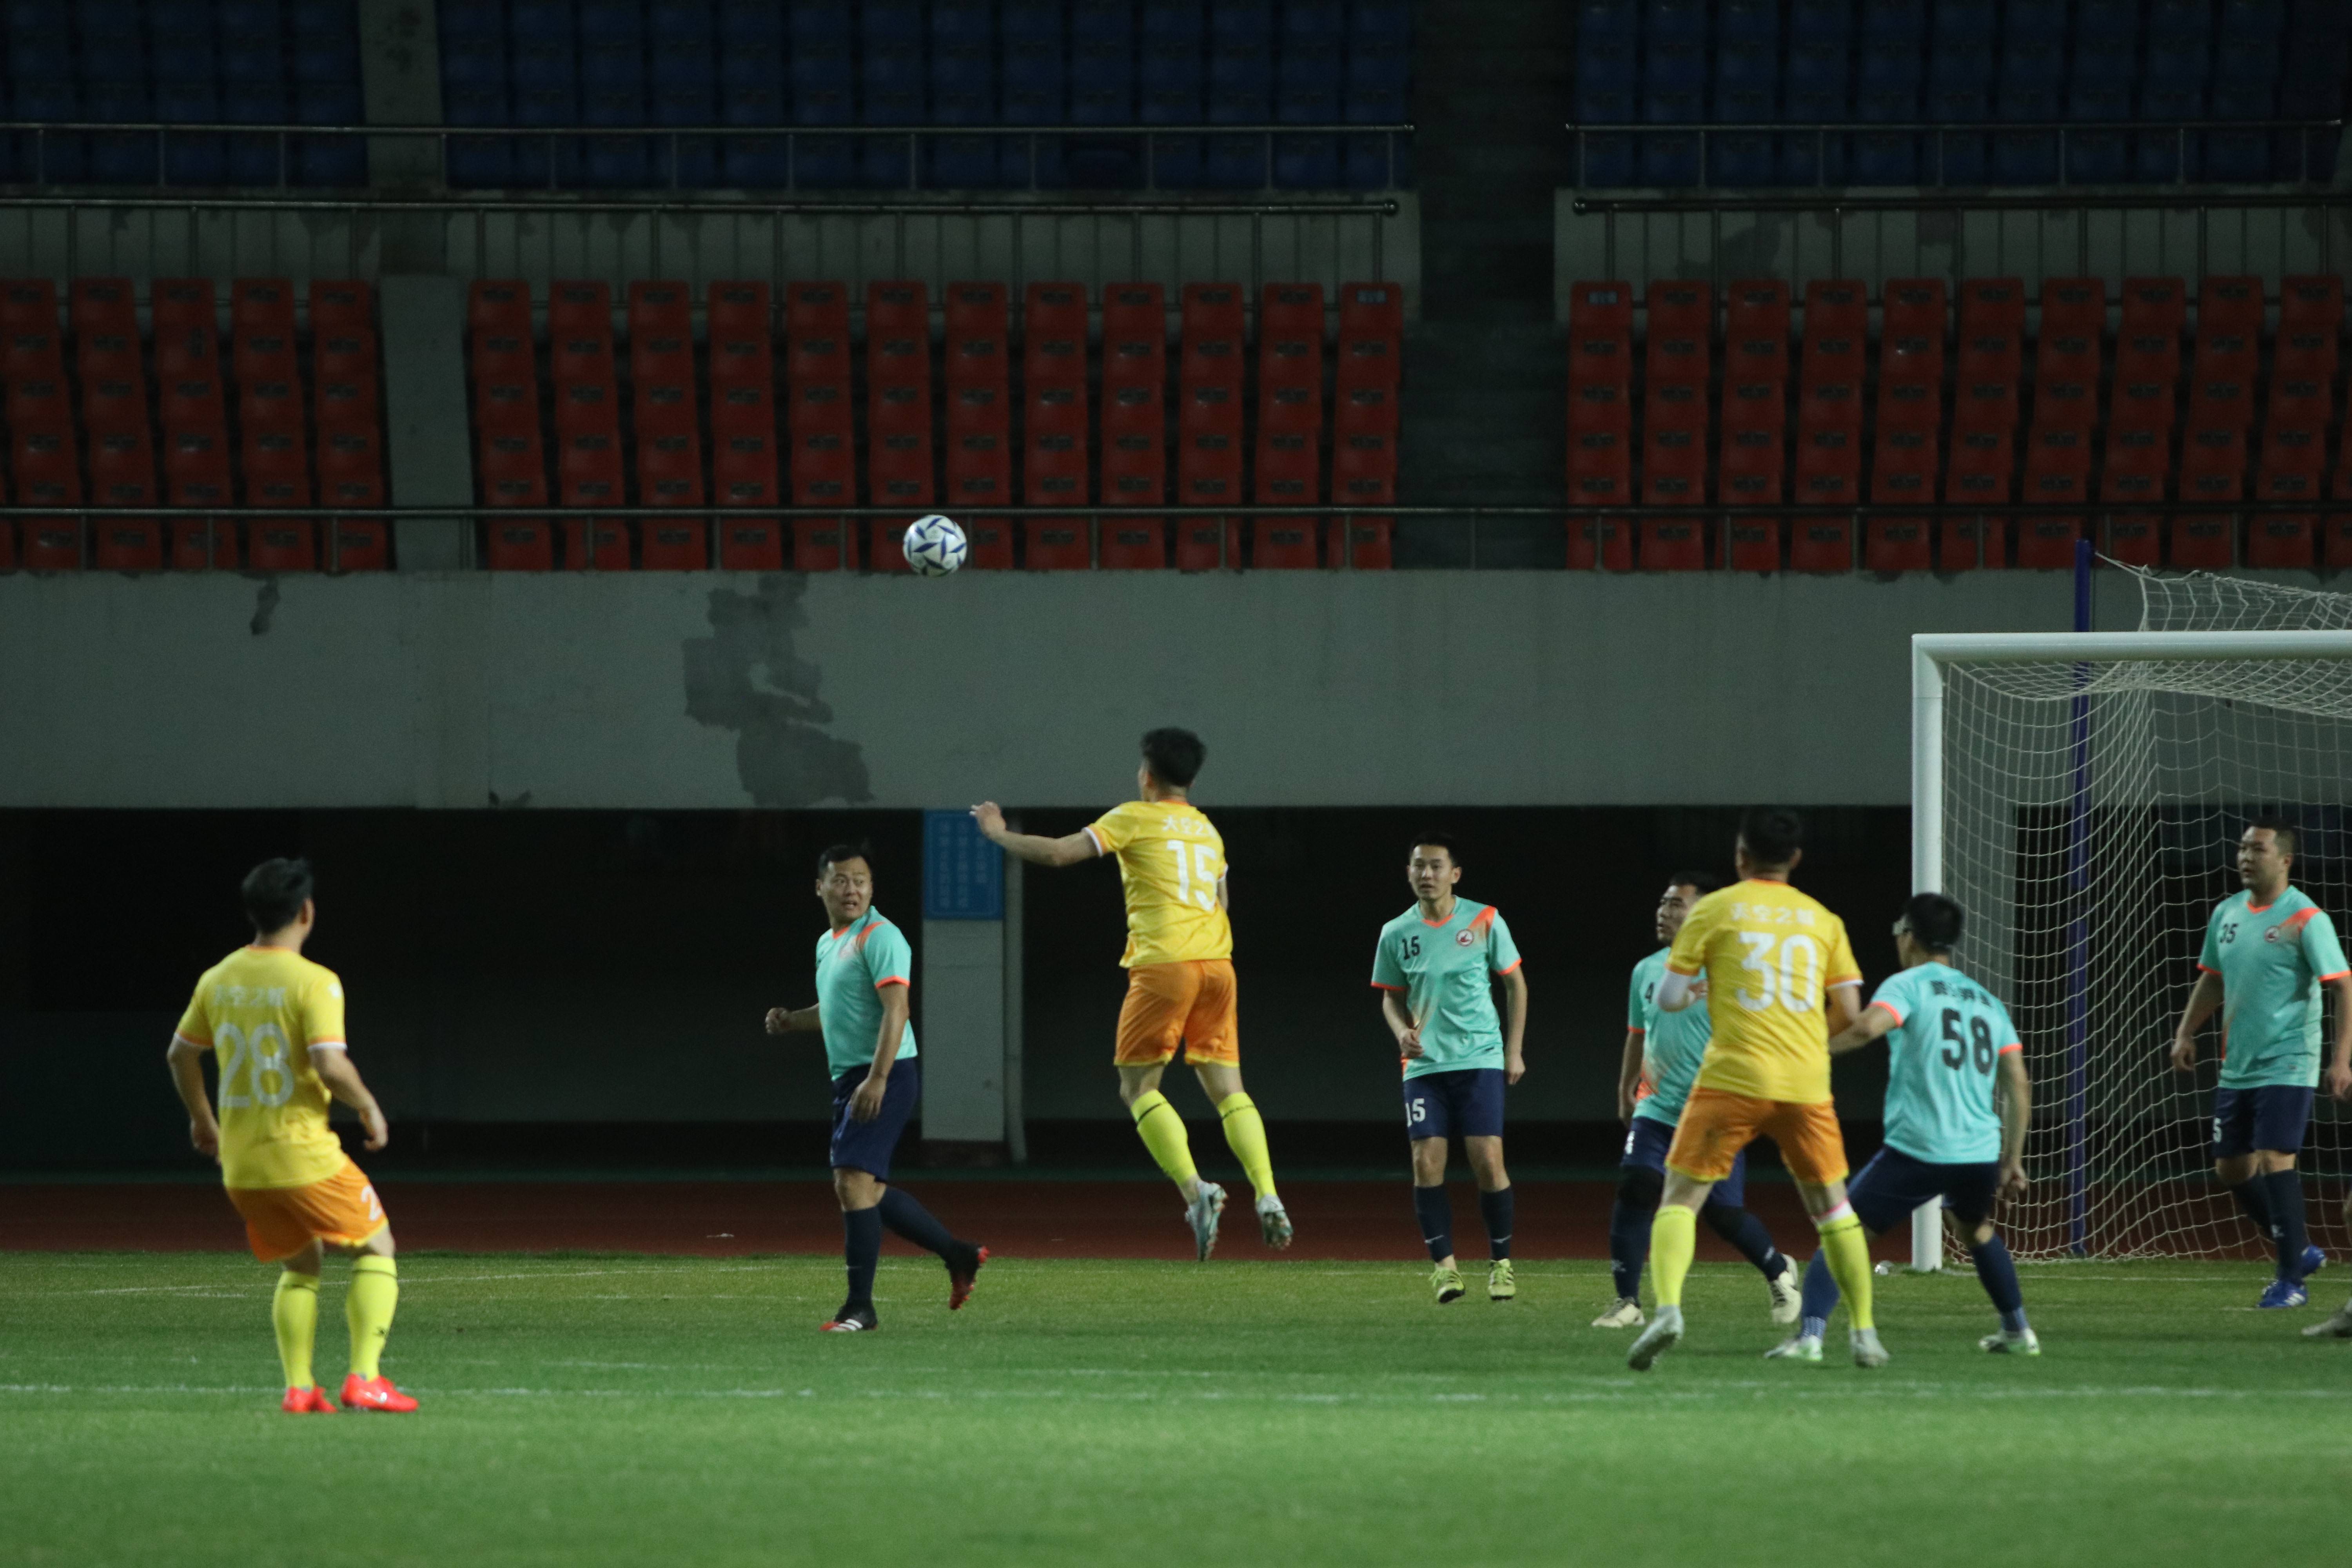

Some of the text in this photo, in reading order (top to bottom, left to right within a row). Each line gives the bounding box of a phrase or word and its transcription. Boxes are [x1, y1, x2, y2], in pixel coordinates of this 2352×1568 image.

[1166, 839, 1218, 911] 15
[1402, 935, 1420, 960] 15
[1735, 931, 1817, 1013] 30
[215, 1022, 294, 1109] 28
[1942, 1007, 1993, 1077] 58
[1405, 1098, 1426, 1127] 15
